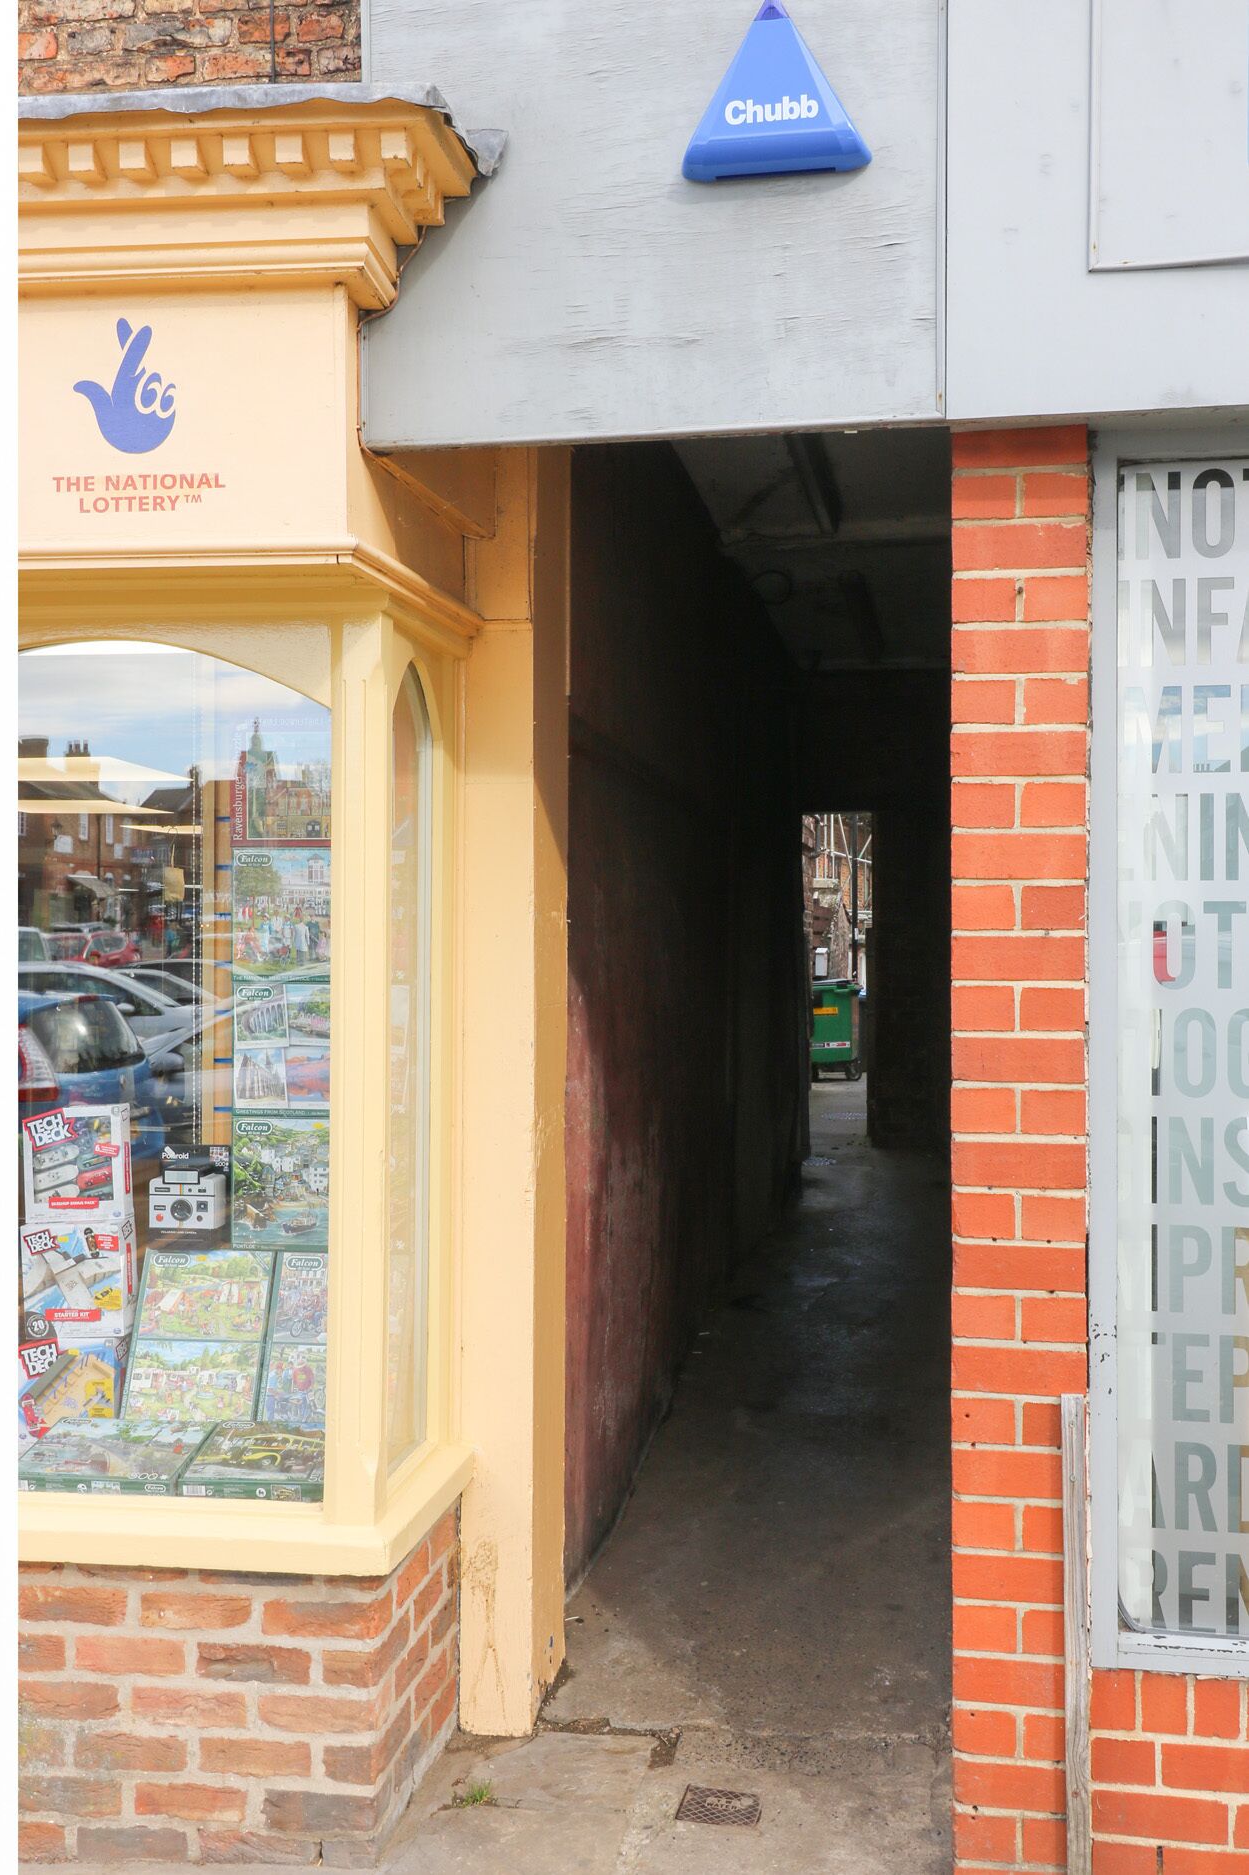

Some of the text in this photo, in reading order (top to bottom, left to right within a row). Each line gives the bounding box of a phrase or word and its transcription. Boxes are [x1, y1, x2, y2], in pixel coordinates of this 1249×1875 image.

[725, 94, 819, 126] Chubb
[52, 473, 226, 493] THE NATIONAL
[1123, 684, 1249, 774] ME
[233, 776, 246, 840] Ravensburger
[241, 855, 268, 863] Falcon
[242, 989, 269, 997] Falcon
[26, 1113, 65, 1137] TECH
[241, 1123, 268, 1131] Falcon
[33, 1124, 73, 1147] DECK
[26, 1231, 51, 1247] TECH
[31, 1237, 56, 1253] DECK
[158, 1255, 186, 1264] Falcon
[290, 1259, 319, 1267] Falcon
[20, 1343, 58, 1363] TECH
[28, 1359, 54, 1376] DEC
[706, 1802, 737, 1810] WATER
